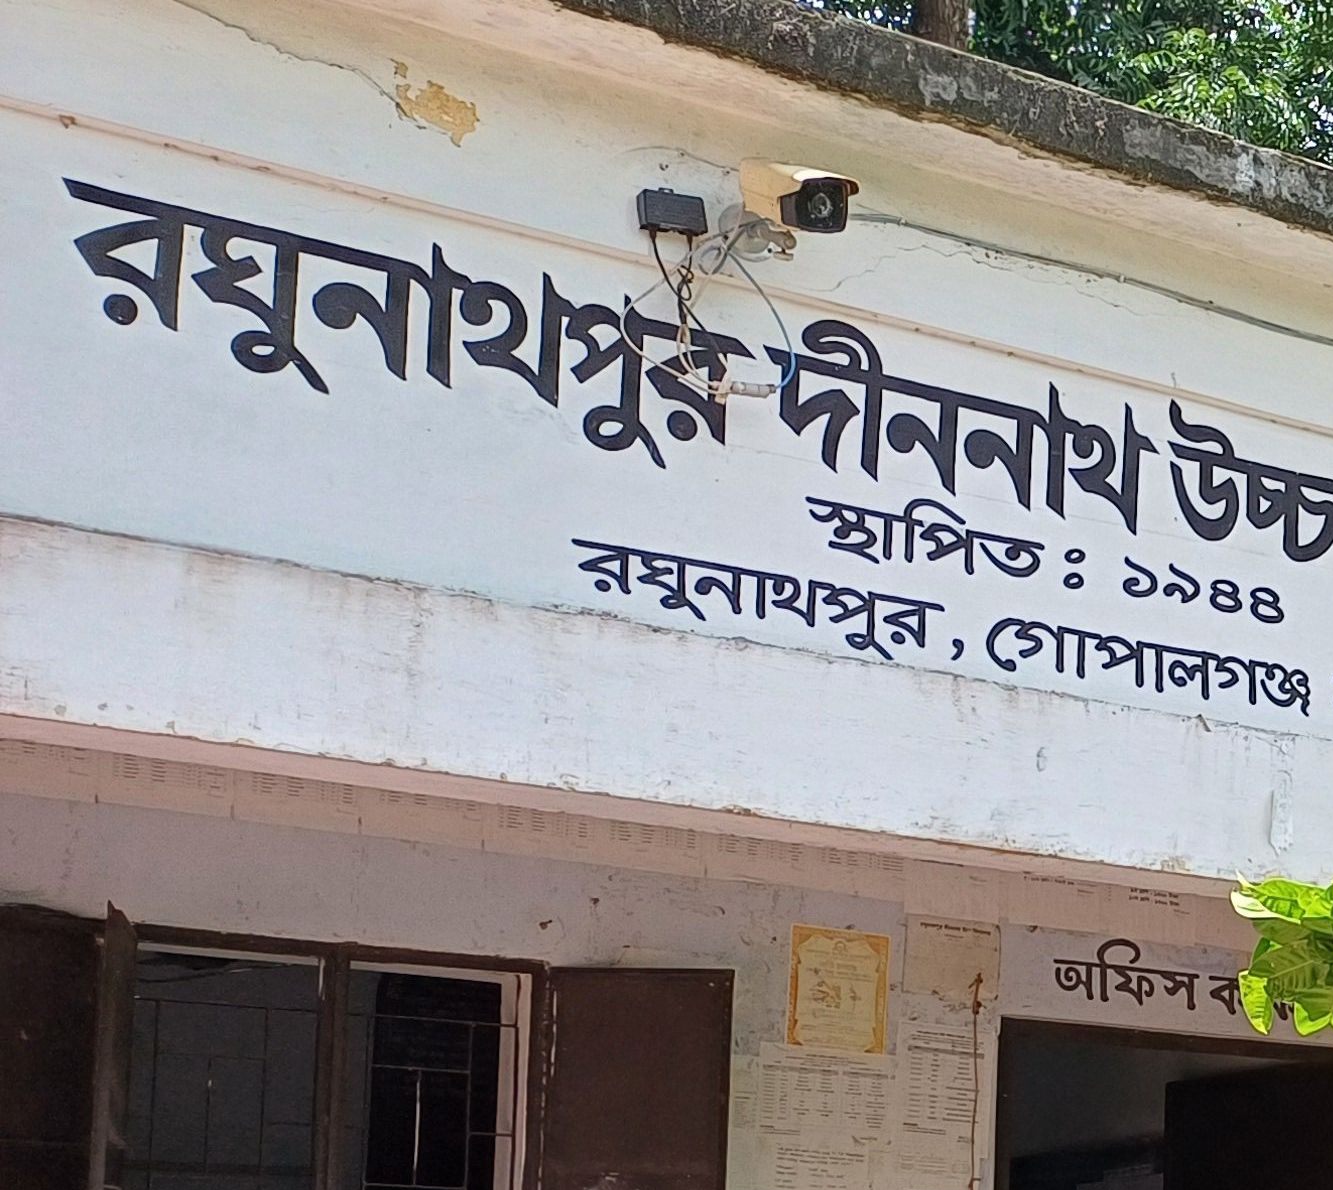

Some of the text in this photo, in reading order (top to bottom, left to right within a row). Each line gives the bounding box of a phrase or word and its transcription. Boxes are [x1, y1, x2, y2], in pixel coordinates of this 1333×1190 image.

[63, 178, 757, 469] রঘুনাথপুর
[765, 319, 1159, 535] দীননাথ
[1123, 556, 1285, 624] ১৯৪৪
[986, 618, 1311, 716] গোপালগঞ্জ
[1053, 938, 1200, 1011] অফিস
